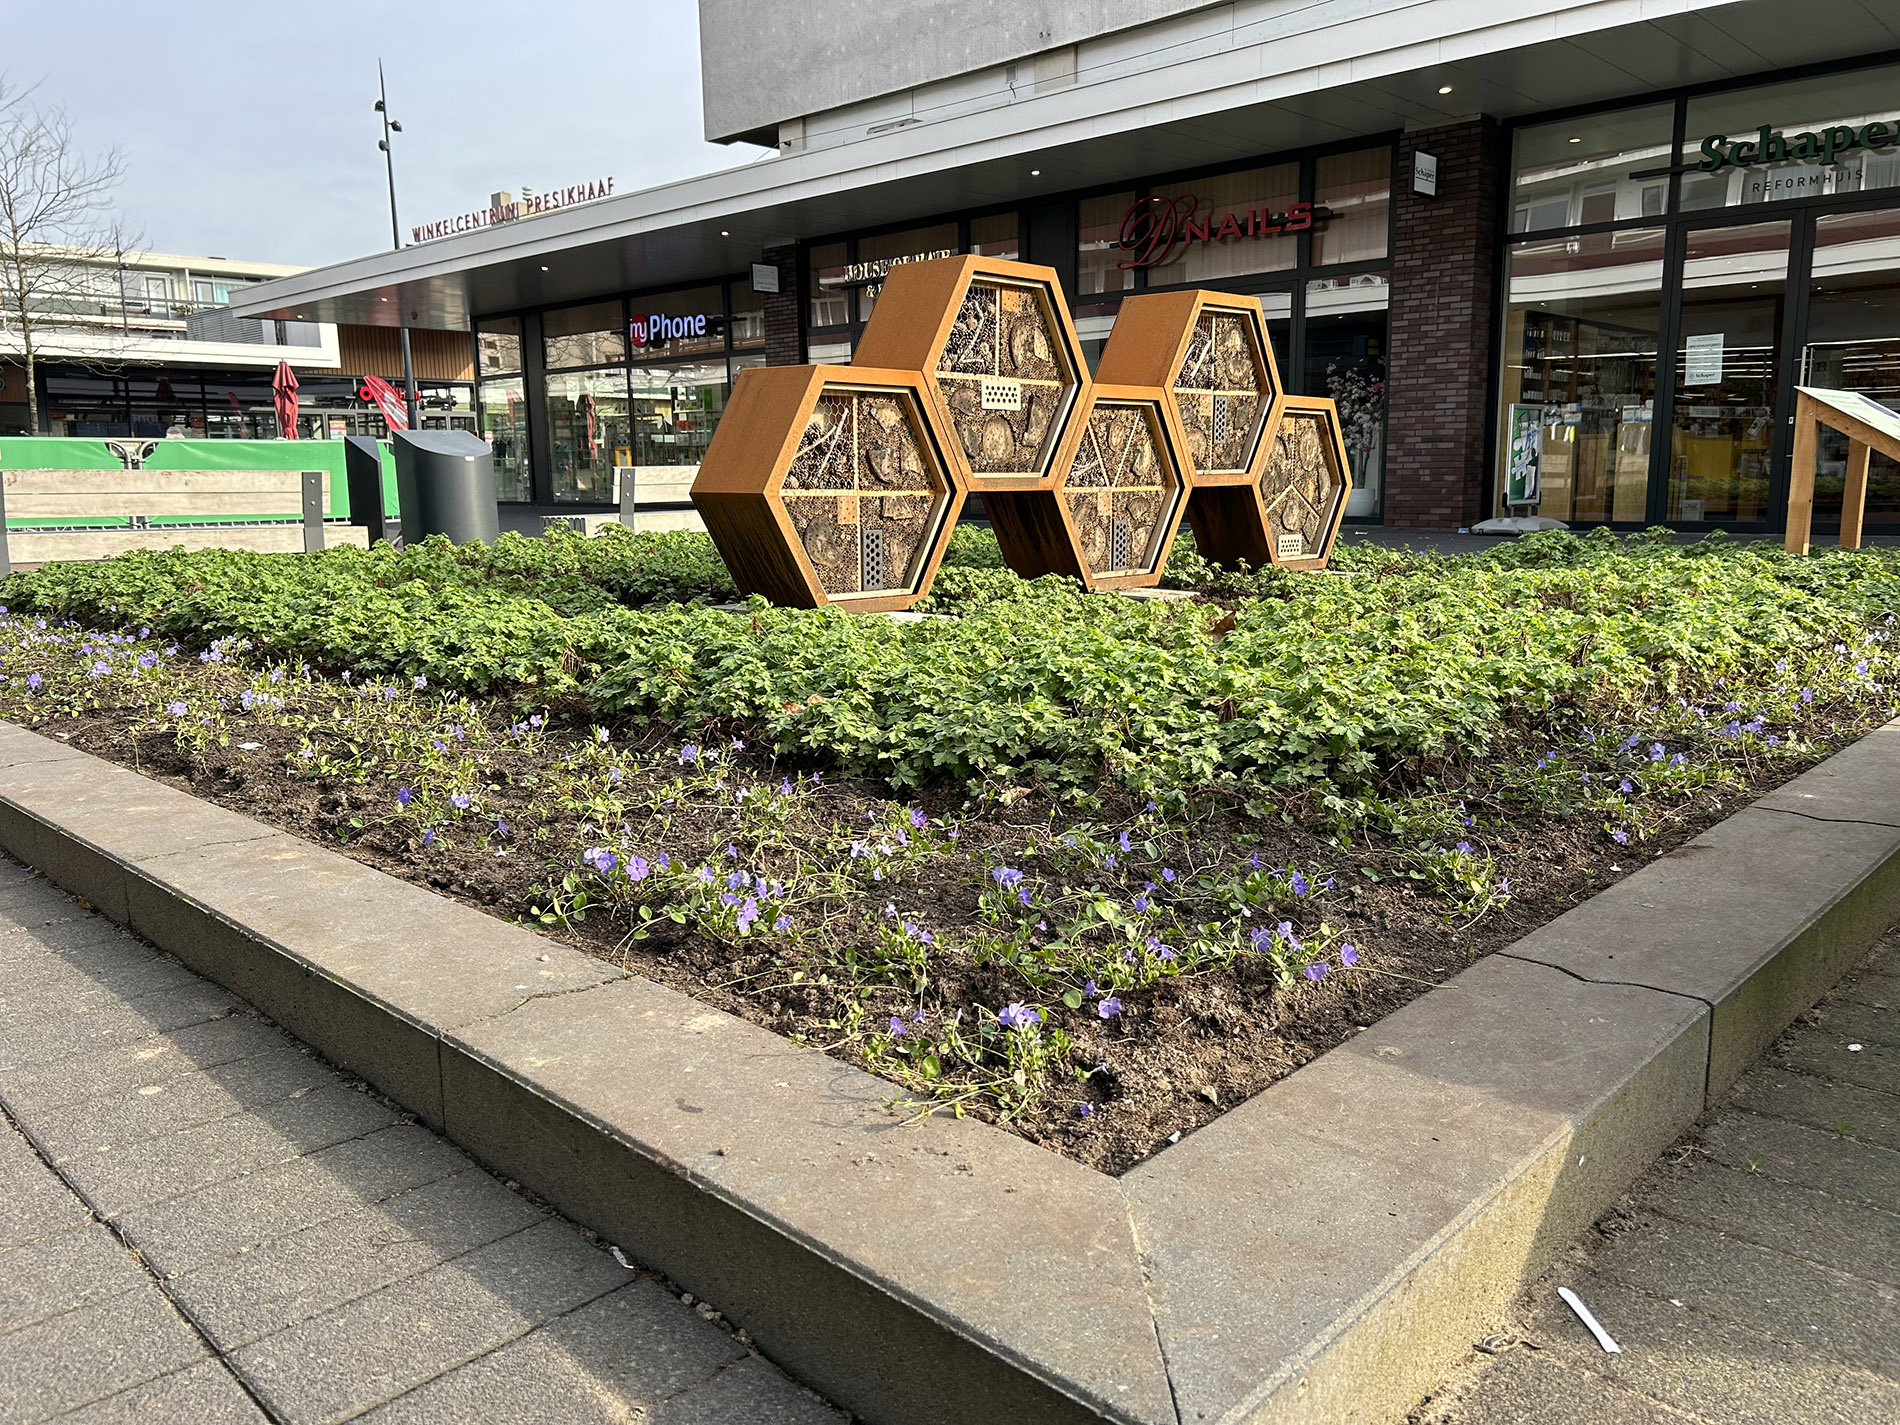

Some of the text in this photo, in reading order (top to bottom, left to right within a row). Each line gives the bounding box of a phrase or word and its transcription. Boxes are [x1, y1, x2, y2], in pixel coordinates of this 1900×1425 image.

[1698, 120, 1900, 172] Schape
[1415, 167, 1435, 181] Schaper
[1752, 169, 1863, 193] REFORMHUIS
[412, 176, 614, 243] WINKELCENTRUM PRESIKHAAF
[1184, 202, 1313, 245] NAILS
[843, 259, 889, 282] HOUSE
